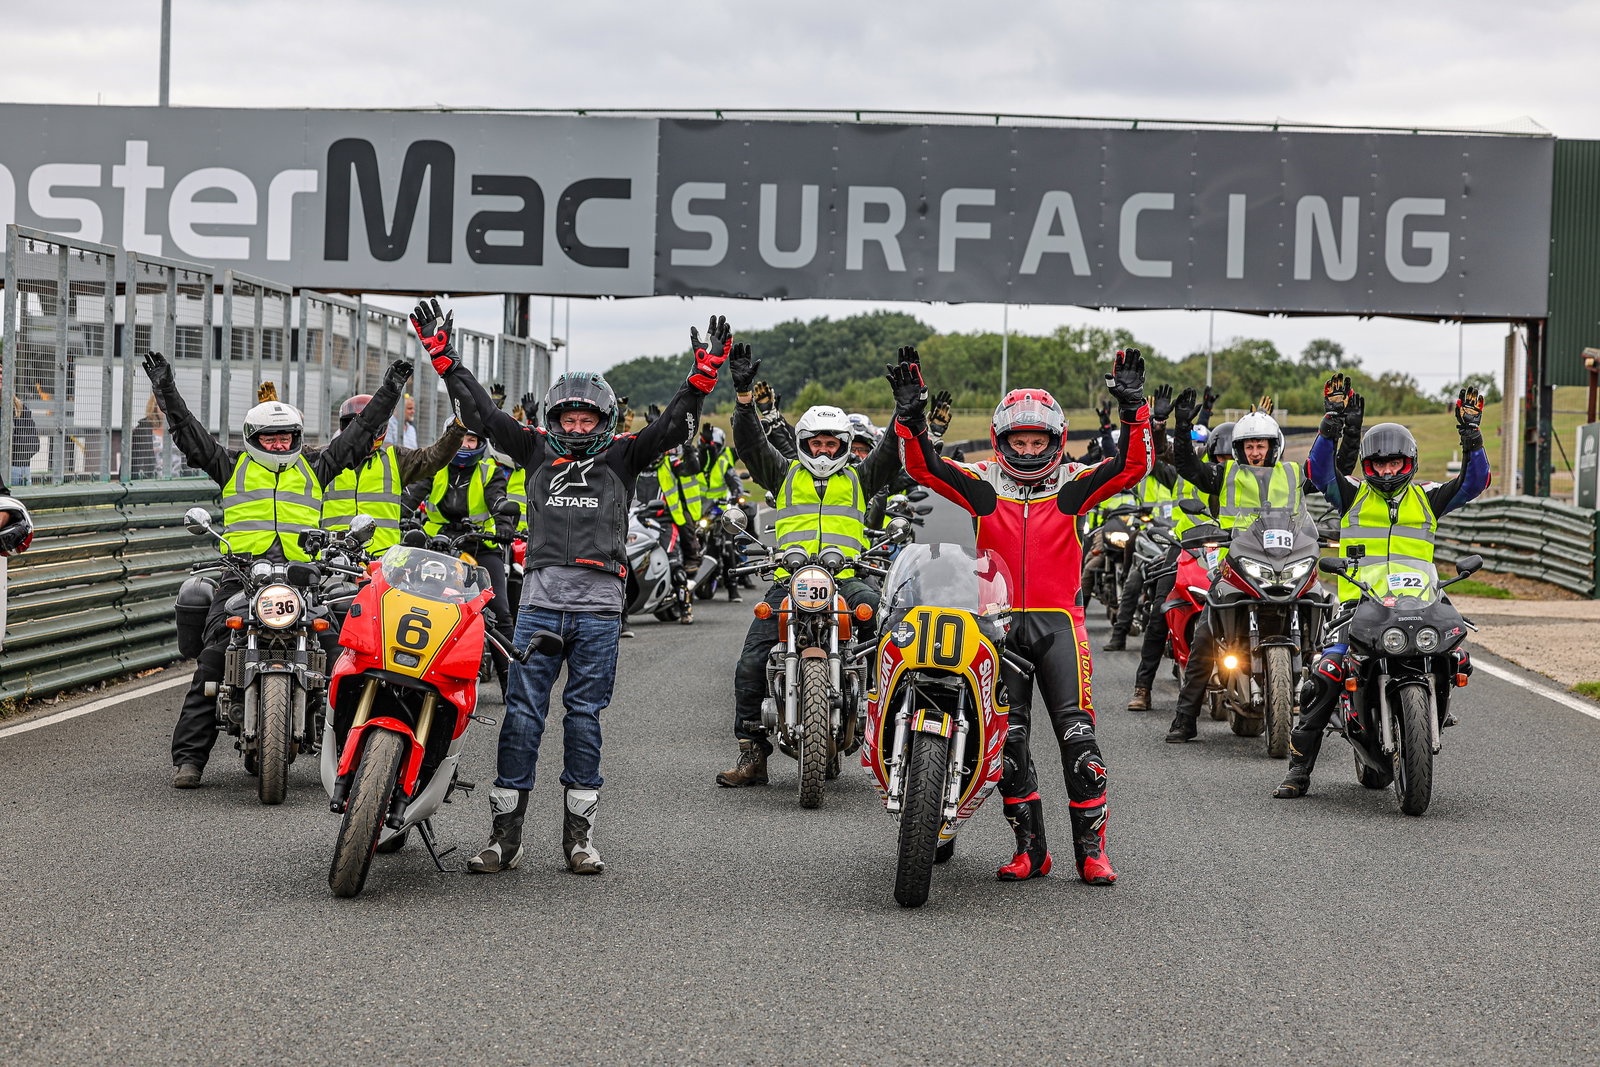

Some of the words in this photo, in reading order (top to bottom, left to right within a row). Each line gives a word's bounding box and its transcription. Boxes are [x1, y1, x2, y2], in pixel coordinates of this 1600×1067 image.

[0, 137, 632, 268] sterMac
[670, 182, 1450, 284] SURFACING
[545, 496, 599, 508] ASTARS
[1276, 536, 1292, 547] 18
[1402, 577, 1423, 587] 22
[809, 586, 828, 600] 30
[275, 600, 295, 615] 36
[396, 613, 432, 650] 6
[916, 611, 965, 668] 10
